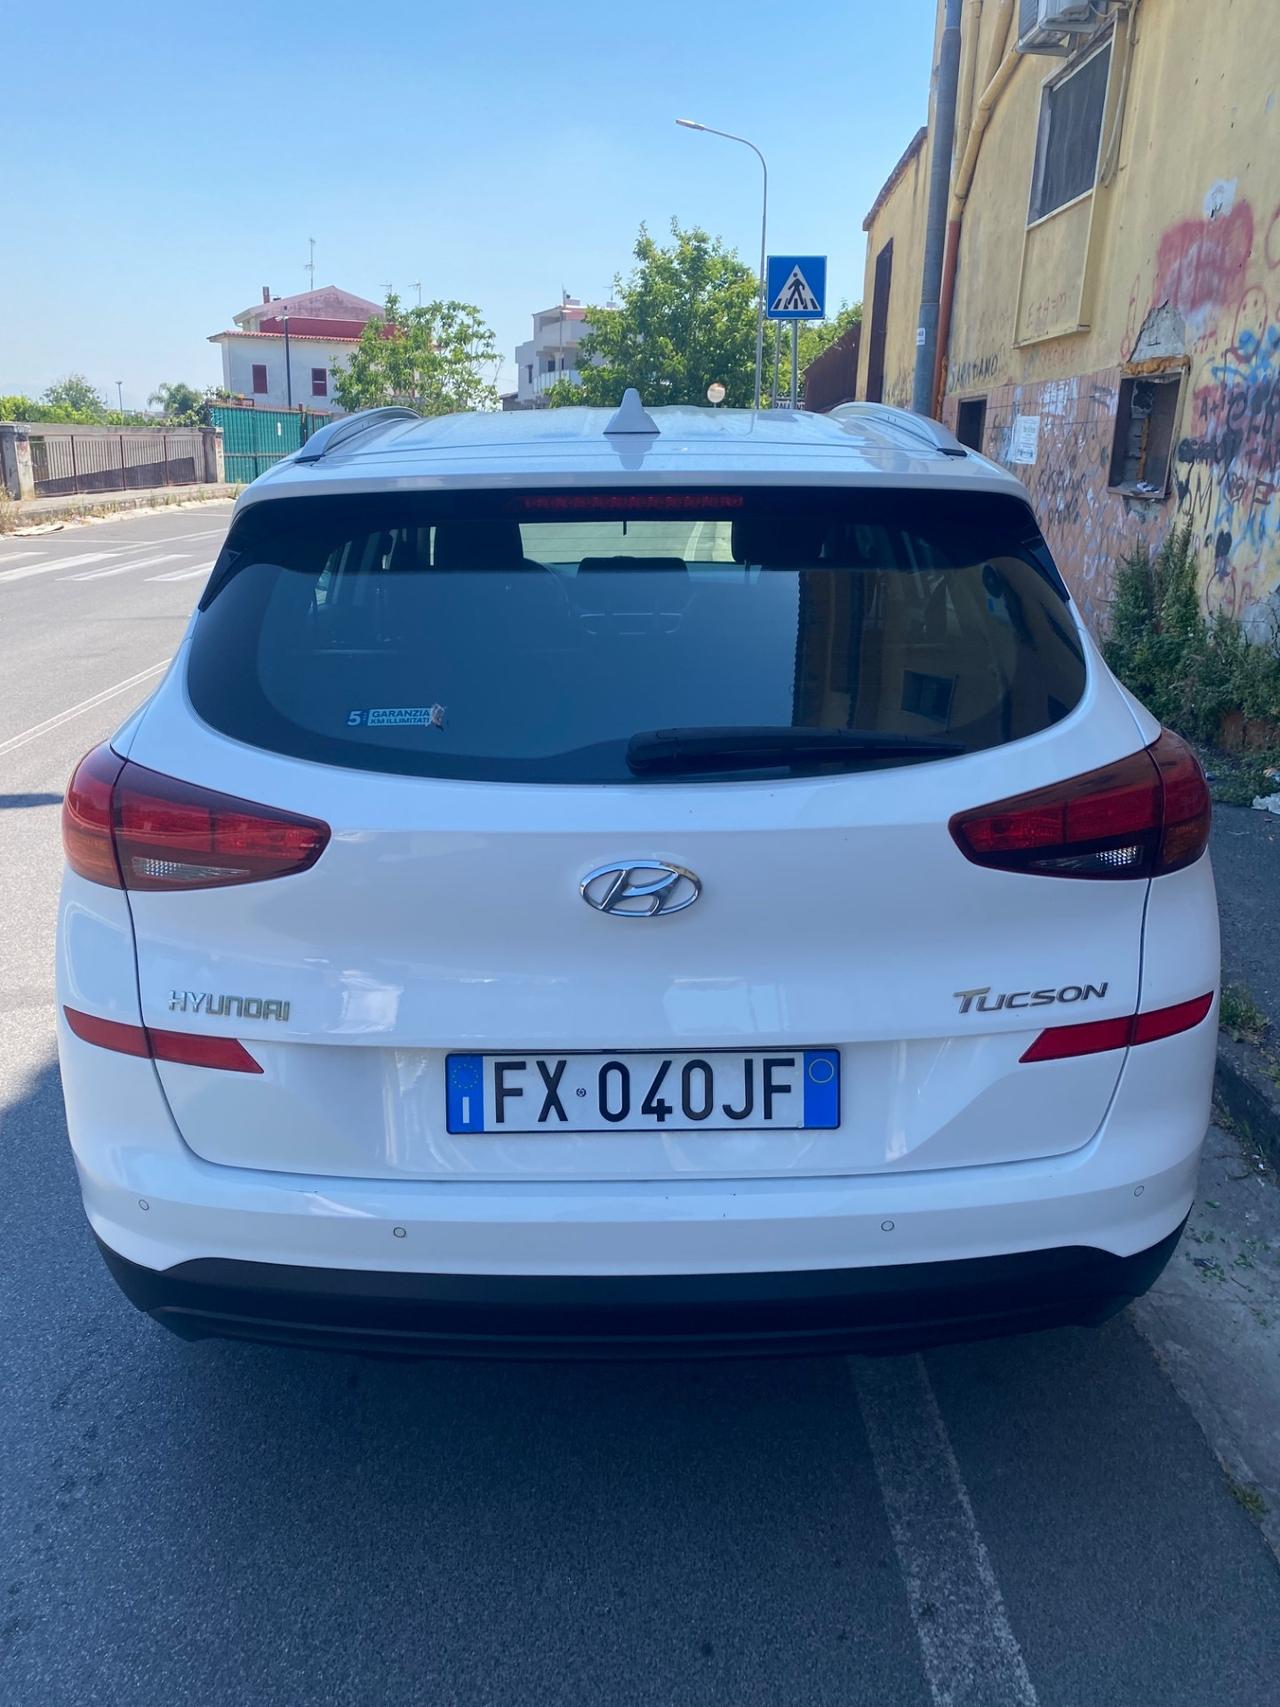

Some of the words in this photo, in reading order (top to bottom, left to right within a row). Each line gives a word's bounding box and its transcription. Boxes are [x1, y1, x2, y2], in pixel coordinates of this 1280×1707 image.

[347, 710, 362, 726] 5
[372, 709, 430, 718] GARANZIA
[168, 989, 291, 1022] HYUNDAI
[953, 982, 1109, 1013] TUCSON
